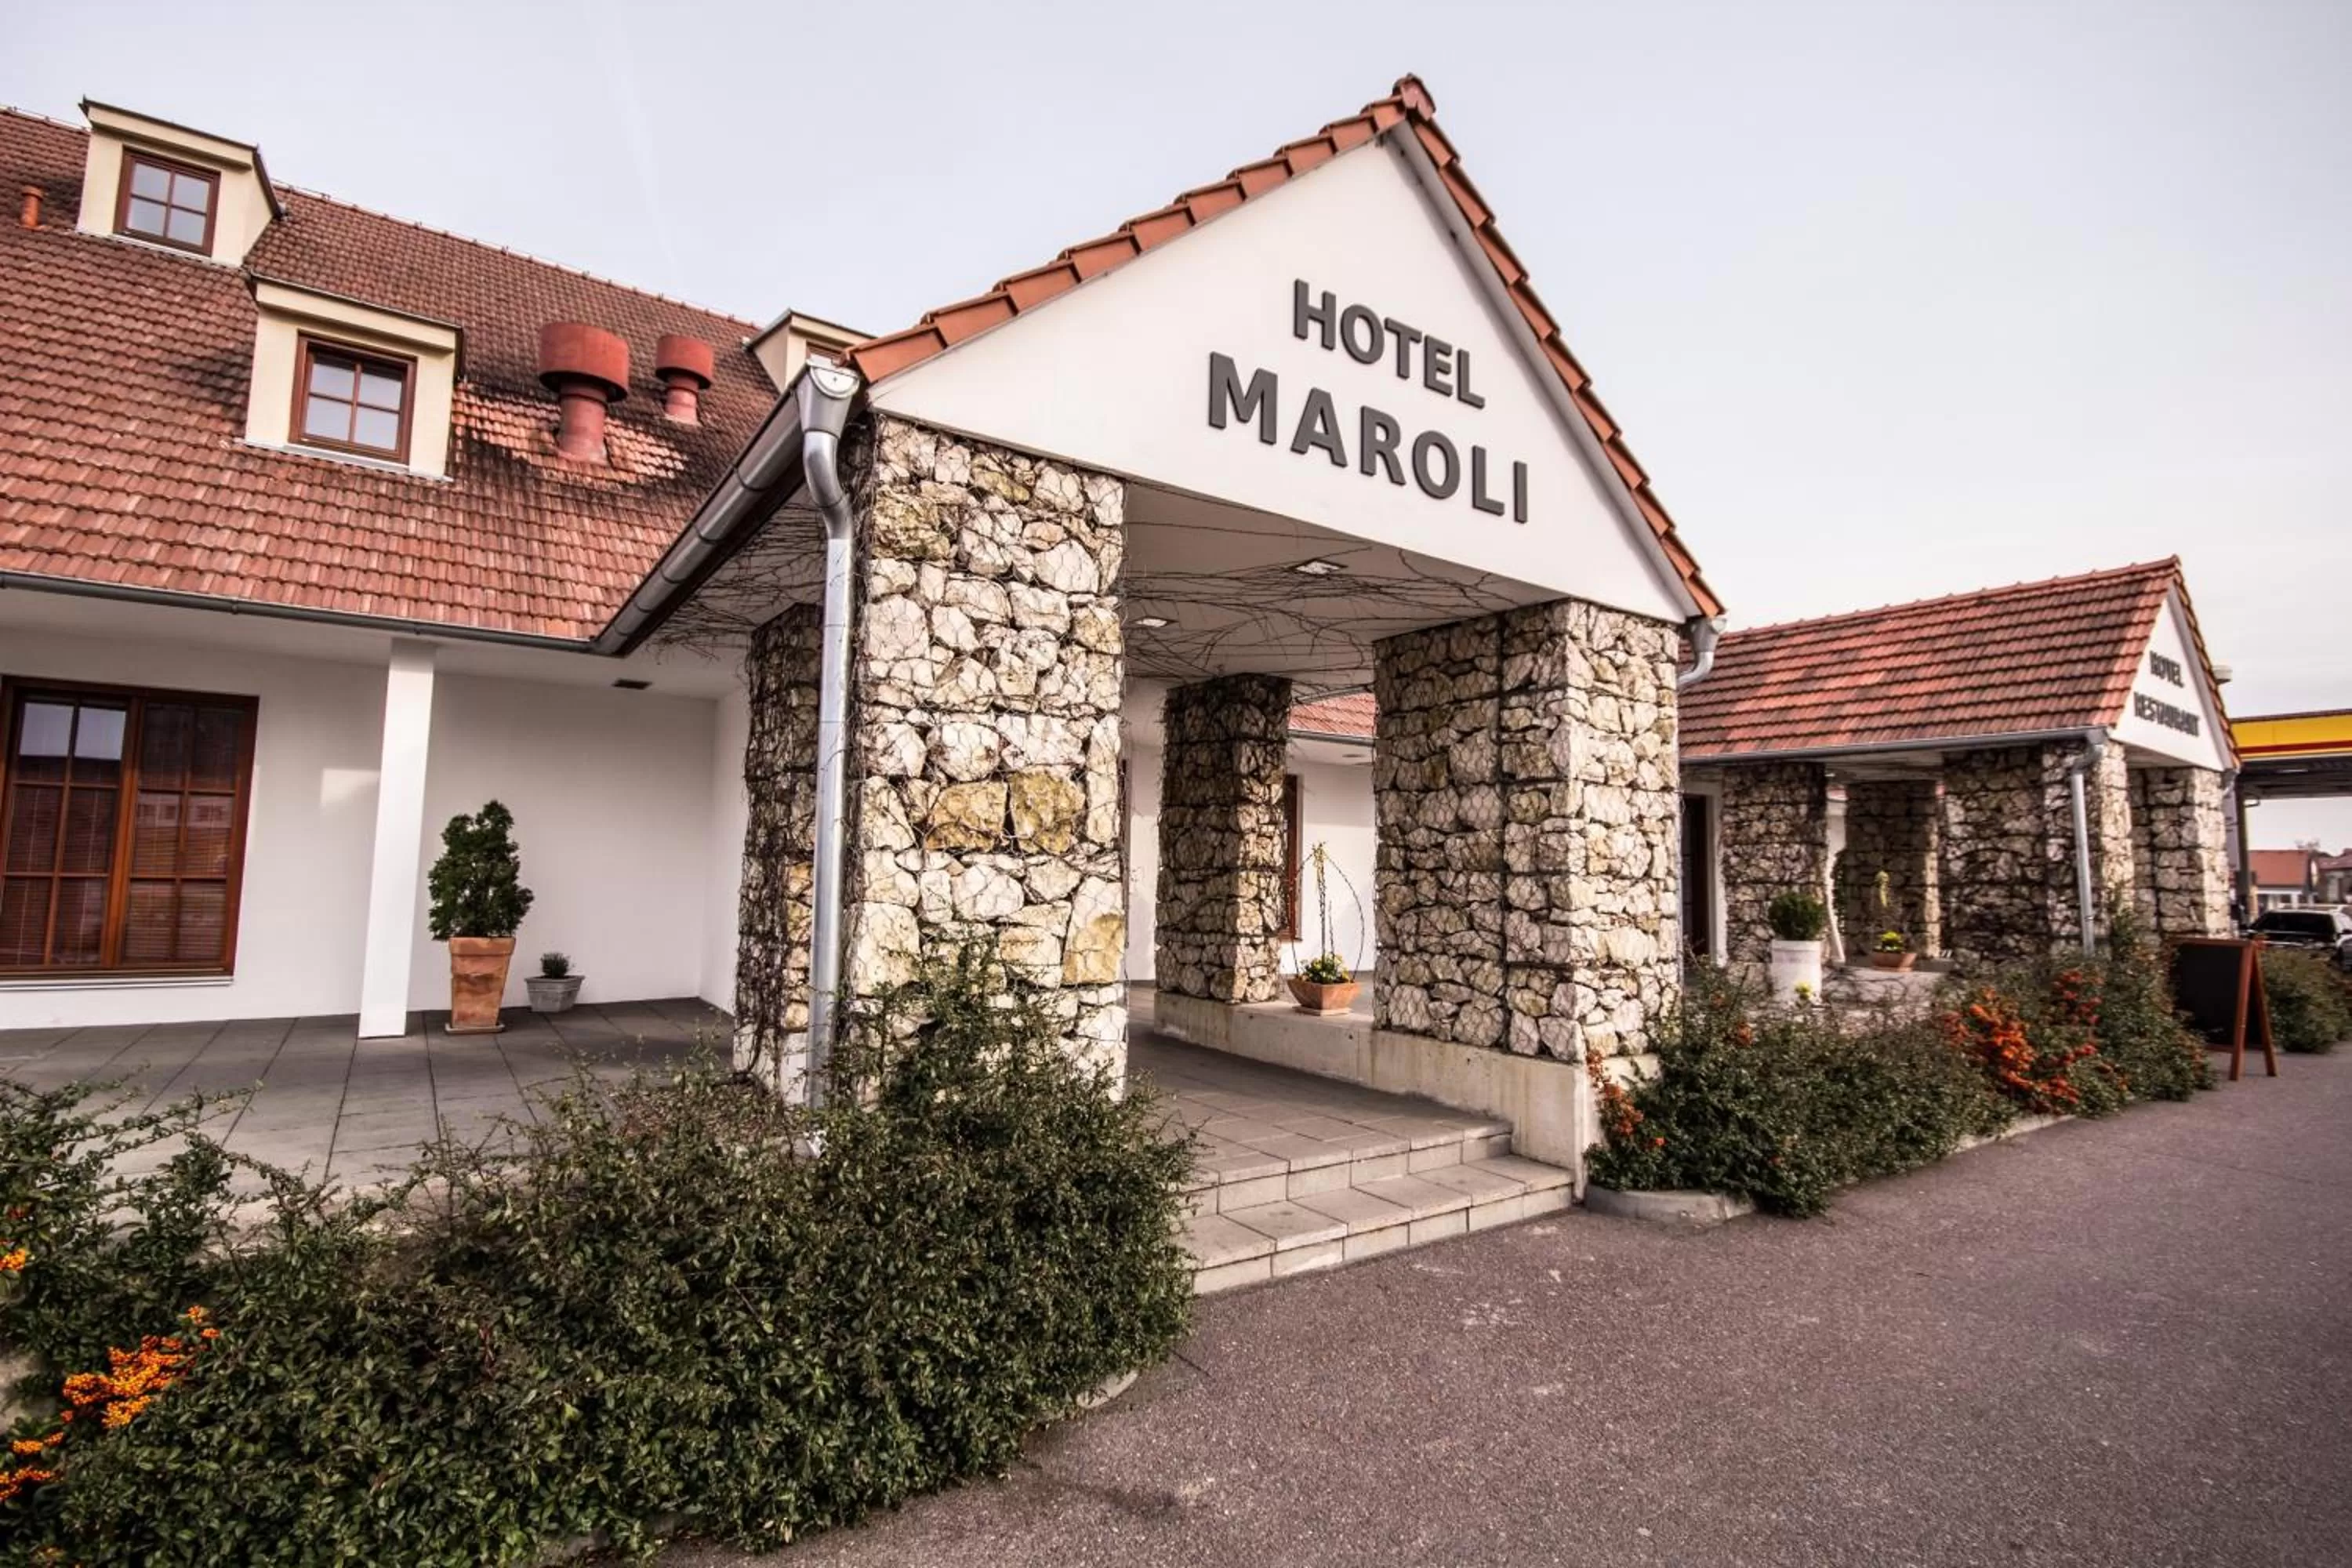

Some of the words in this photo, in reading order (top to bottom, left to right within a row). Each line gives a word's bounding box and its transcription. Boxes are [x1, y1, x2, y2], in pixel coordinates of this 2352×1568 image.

[1294, 278, 1485, 408] HOTEL
[1208, 351, 1528, 524] MAROLI
[2150, 651, 2184, 688] HOTEL
